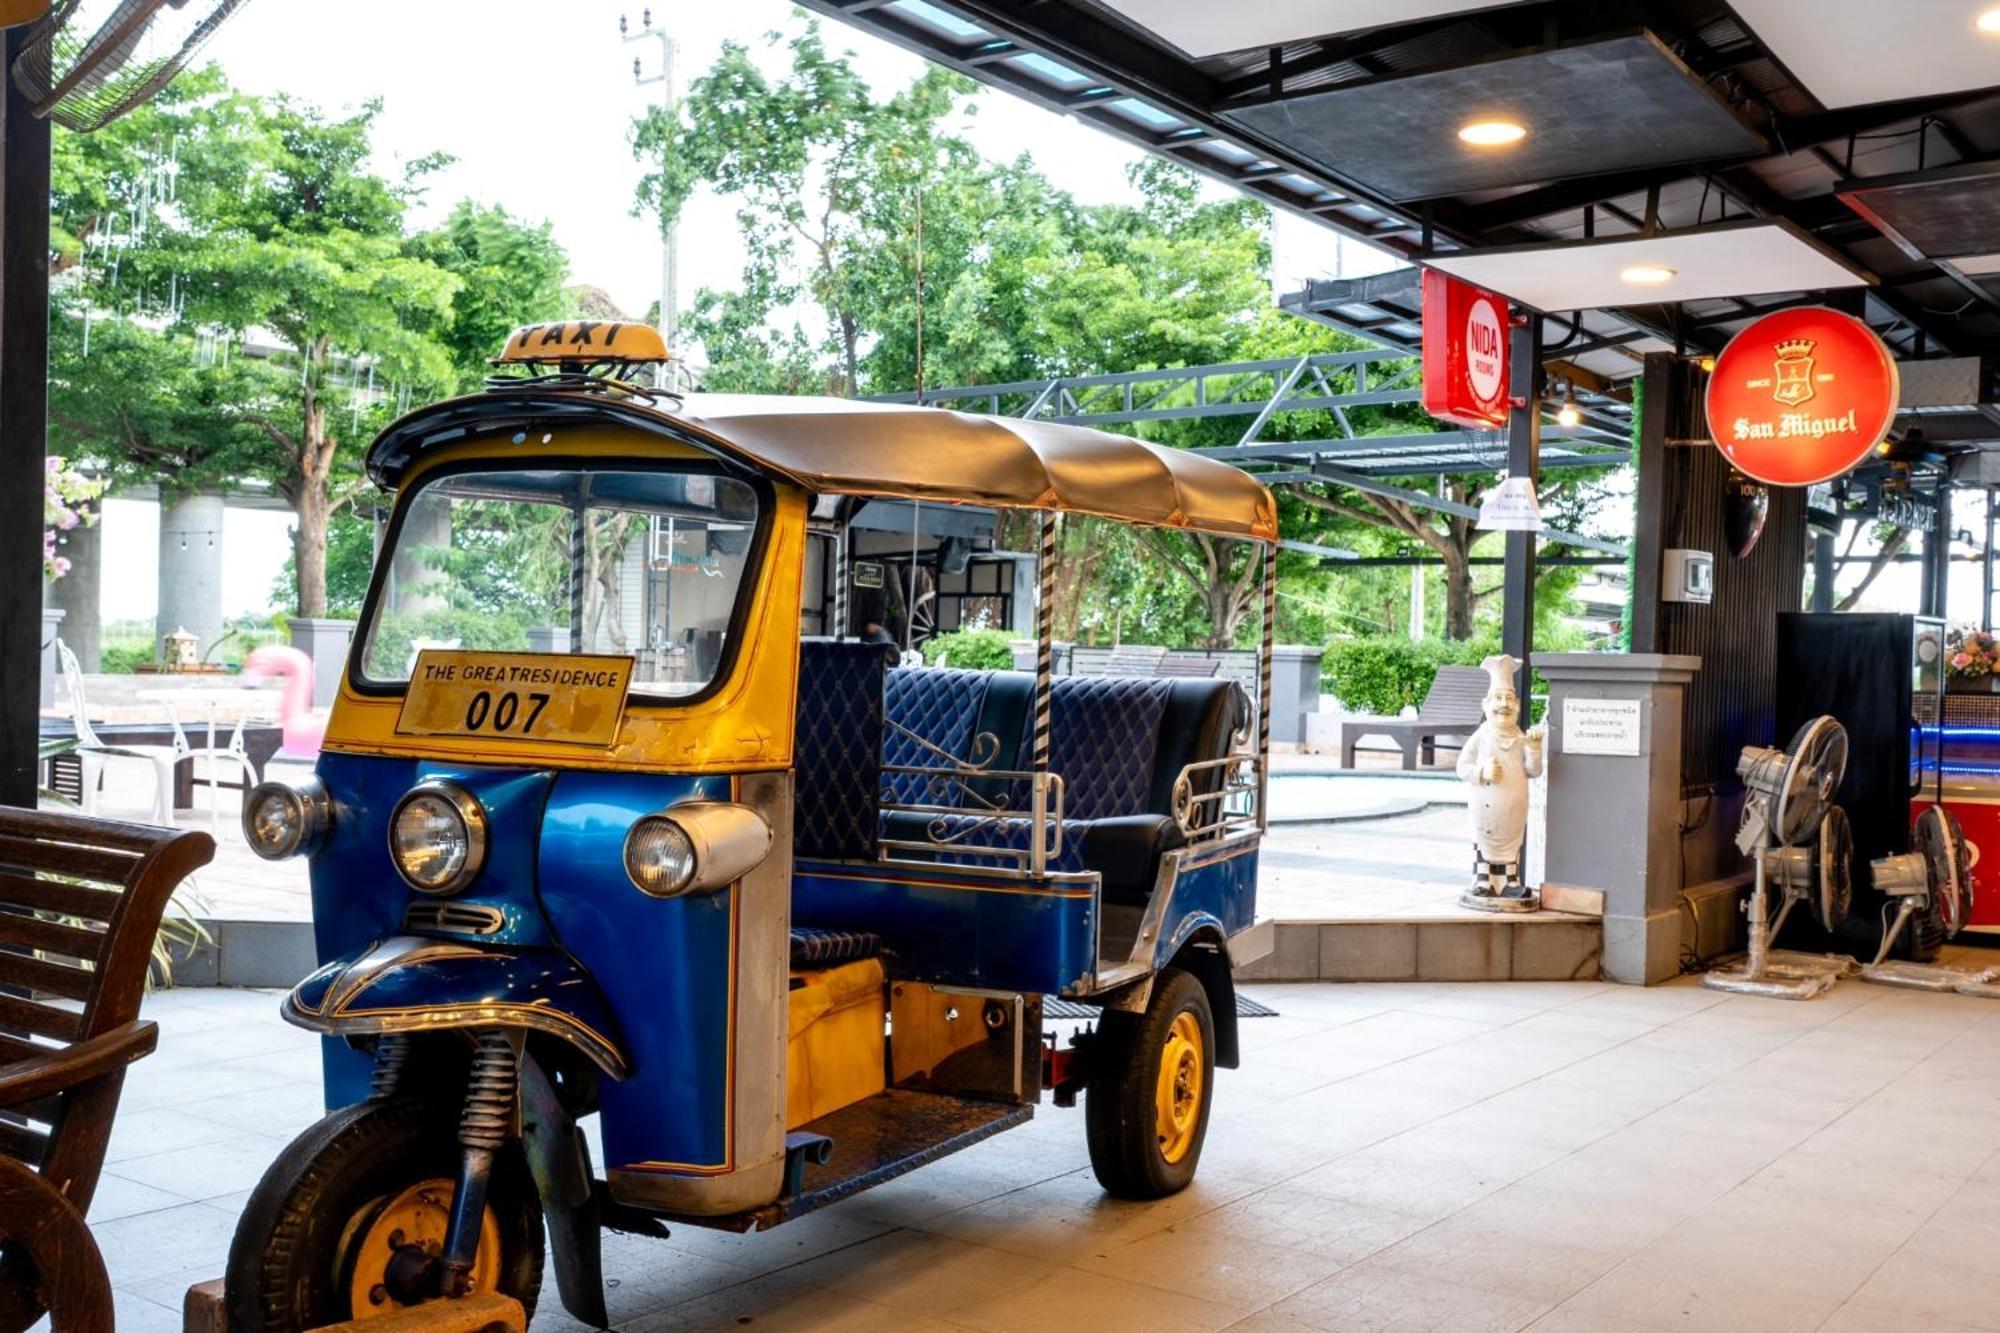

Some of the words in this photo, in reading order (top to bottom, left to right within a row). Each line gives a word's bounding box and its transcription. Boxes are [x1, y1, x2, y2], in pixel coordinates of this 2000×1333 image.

[519, 321, 622, 347] TAXI
[1471, 320, 1498, 359] NIDA
[1733, 416, 1775, 440] San
[1778, 408, 1857, 441] Miguel
[425, 664, 455, 681] THE
[465, 690, 551, 734] 007
